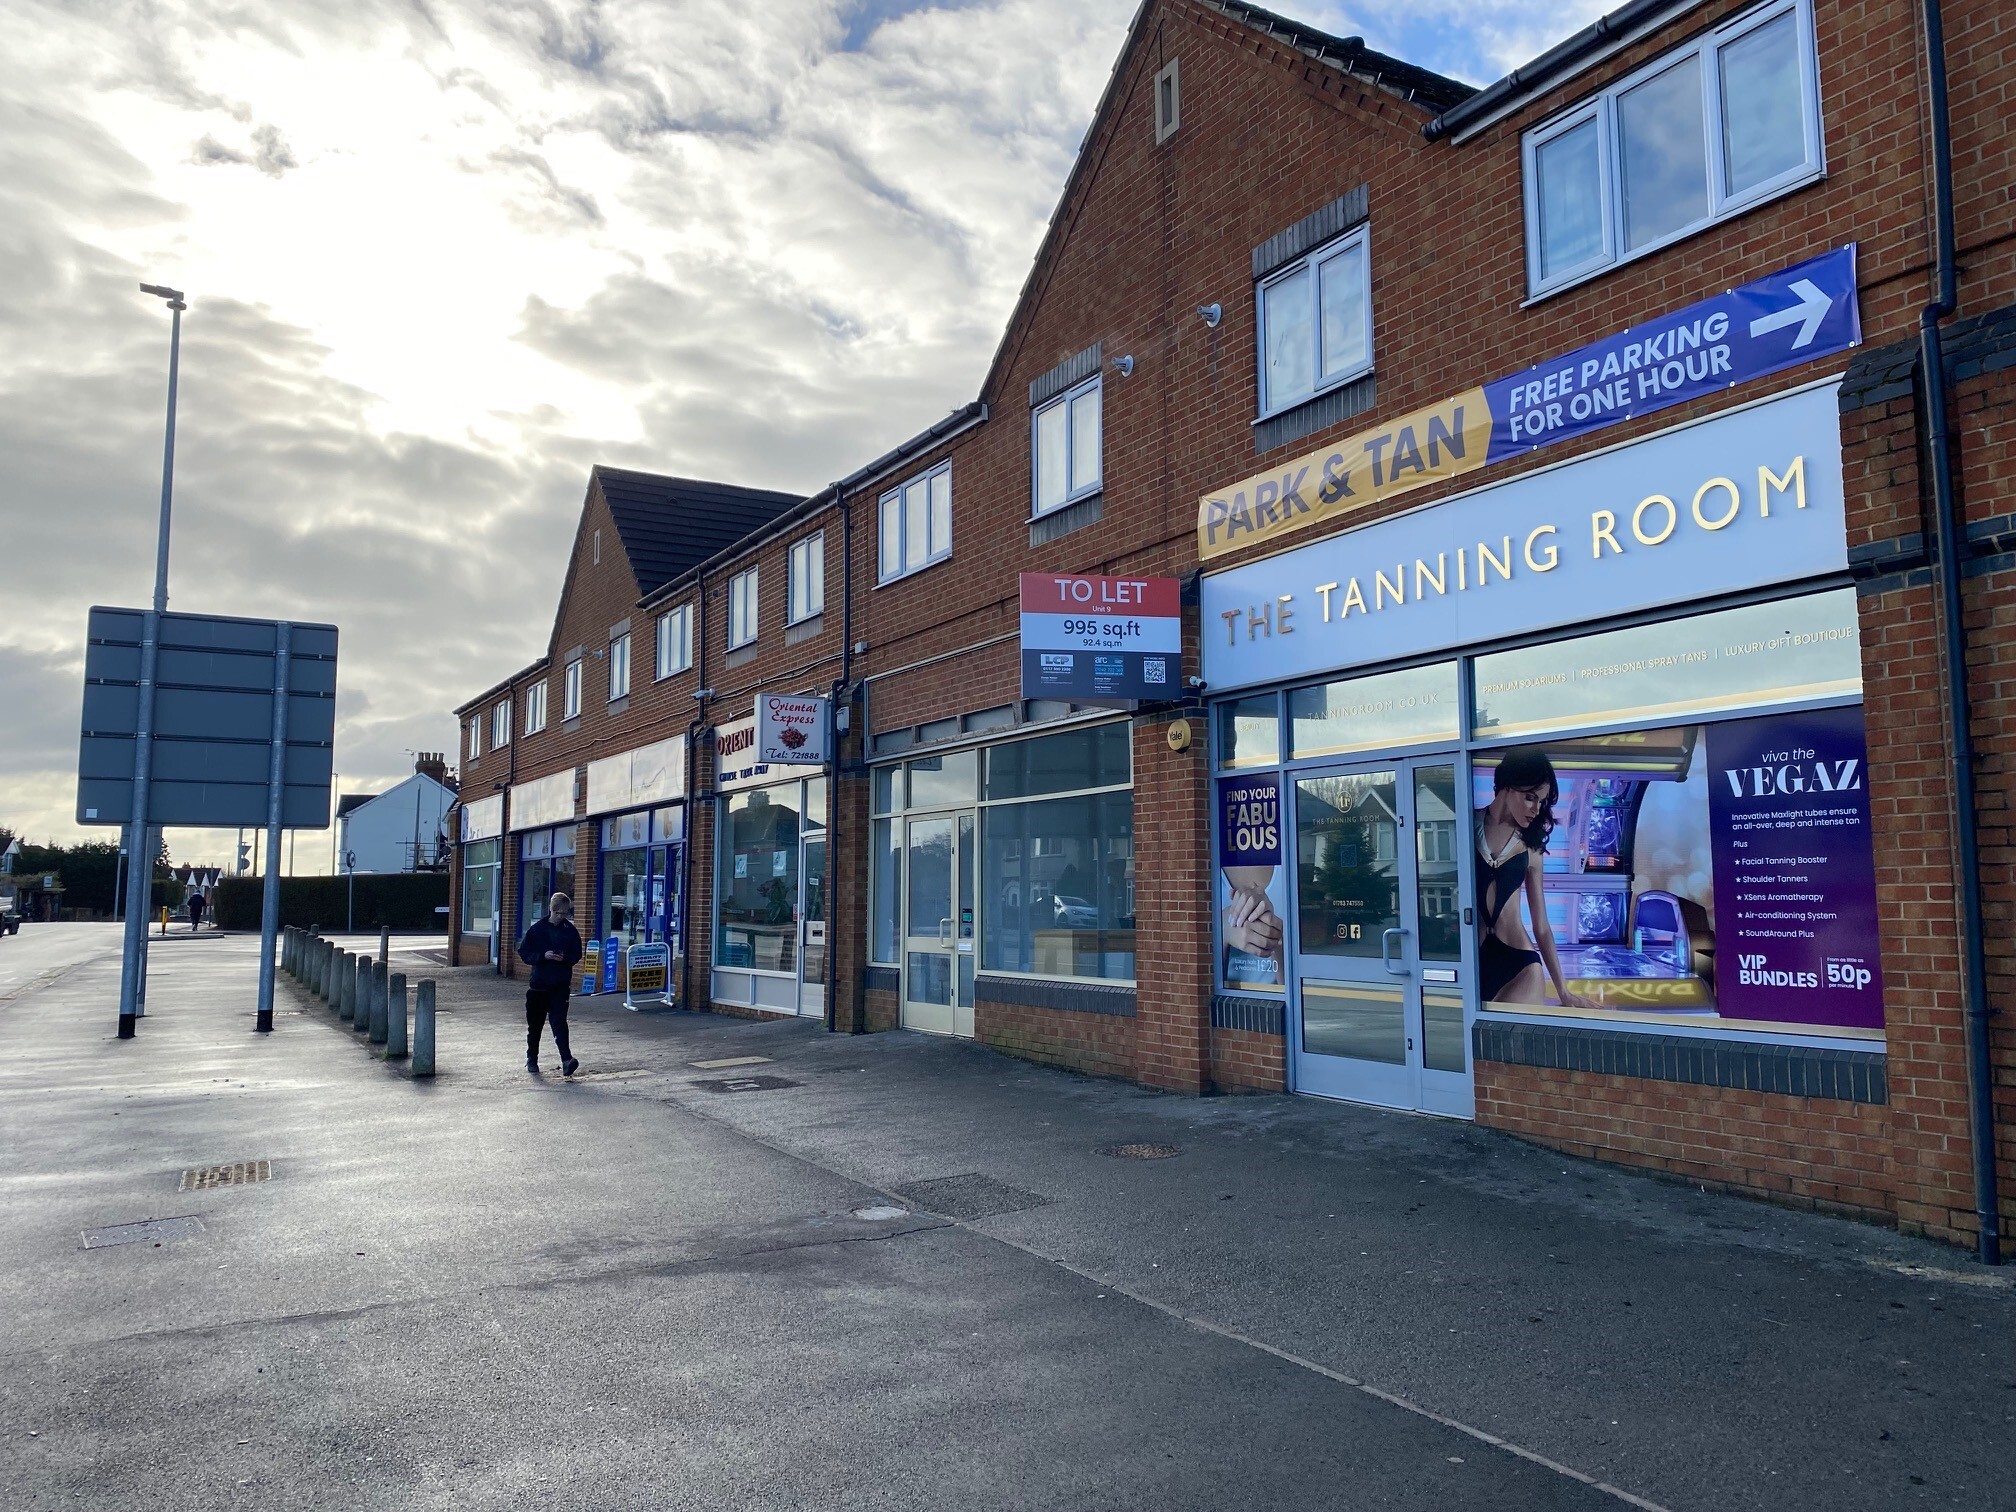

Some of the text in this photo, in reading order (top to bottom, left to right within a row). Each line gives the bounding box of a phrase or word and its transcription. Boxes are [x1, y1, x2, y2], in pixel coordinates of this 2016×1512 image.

[1509, 311, 1729, 414] FREE PARKING
[1509, 344, 1733, 443] FOR ONE HOUR
[1206, 405, 1467, 546] PARK & TAN
[1220, 455, 1807, 646] THE TANNING ROOM
[1054, 579, 1148, 604] TO LET
[1092, 605, 1105, 613] Unit
[1063, 619, 1141, 639] 995 sq.ft
[1082, 638, 1122, 649] 92.4 sq.m
[1725, 626, 1854, 657] LUXURY GIFT BOUTIQUE
[1044, 655, 1070, 665] LCP
[1094, 655, 1108, 664] arc
[1581, 650, 1708, 679] PROFESSIONAL SPRAY TANS
[1482, 673, 1568, 694] PREMIUM SOLARIUMS
[768, 697, 818, 713] Oriental
[771, 710, 815, 726] Express
[1169, 730, 1183, 741] Yale
[765, 748, 820, 760] Tel: 721888
[1761, 748, 1815, 763] viva the
[1724, 758, 1861, 798] VEGAZ
[1226, 786, 1276, 803] FIND YOUR
[1226, 802, 1277, 828] FABU
[1312, 814, 1381, 826] THE TANNING ROOM
[1731, 808, 1857, 821] Innovative Maxlight tubes ensure
[1743, 821, 1775, 830] all-over,
[1775, 820, 1796, 829] deep
[1796, 818, 1813, 827] and
[1814, 818, 1844, 826] intense
[1845, 817, 1860, 825] tan
[1227, 825, 1278, 852] LOUS
[1733, 840, 1748, 848] Plus
[1741, 856, 1828, 867] Facial Tanning Booster
[1742, 875, 1808, 883] Shoulder Tanners
[1767, 893, 1824, 902] Aromatherapy
[1744, 911, 1837, 922] Air-conditioning System
[1745, 929, 1815, 938] SoundAround Plus
[1260, 959, 1279, 973] £20
[1738, 954, 1768, 970] VIP
[631, 969, 662, 978] FREE
[1739, 969, 1819, 988] BUNDLES
[1827, 963, 1872, 990] 50p
